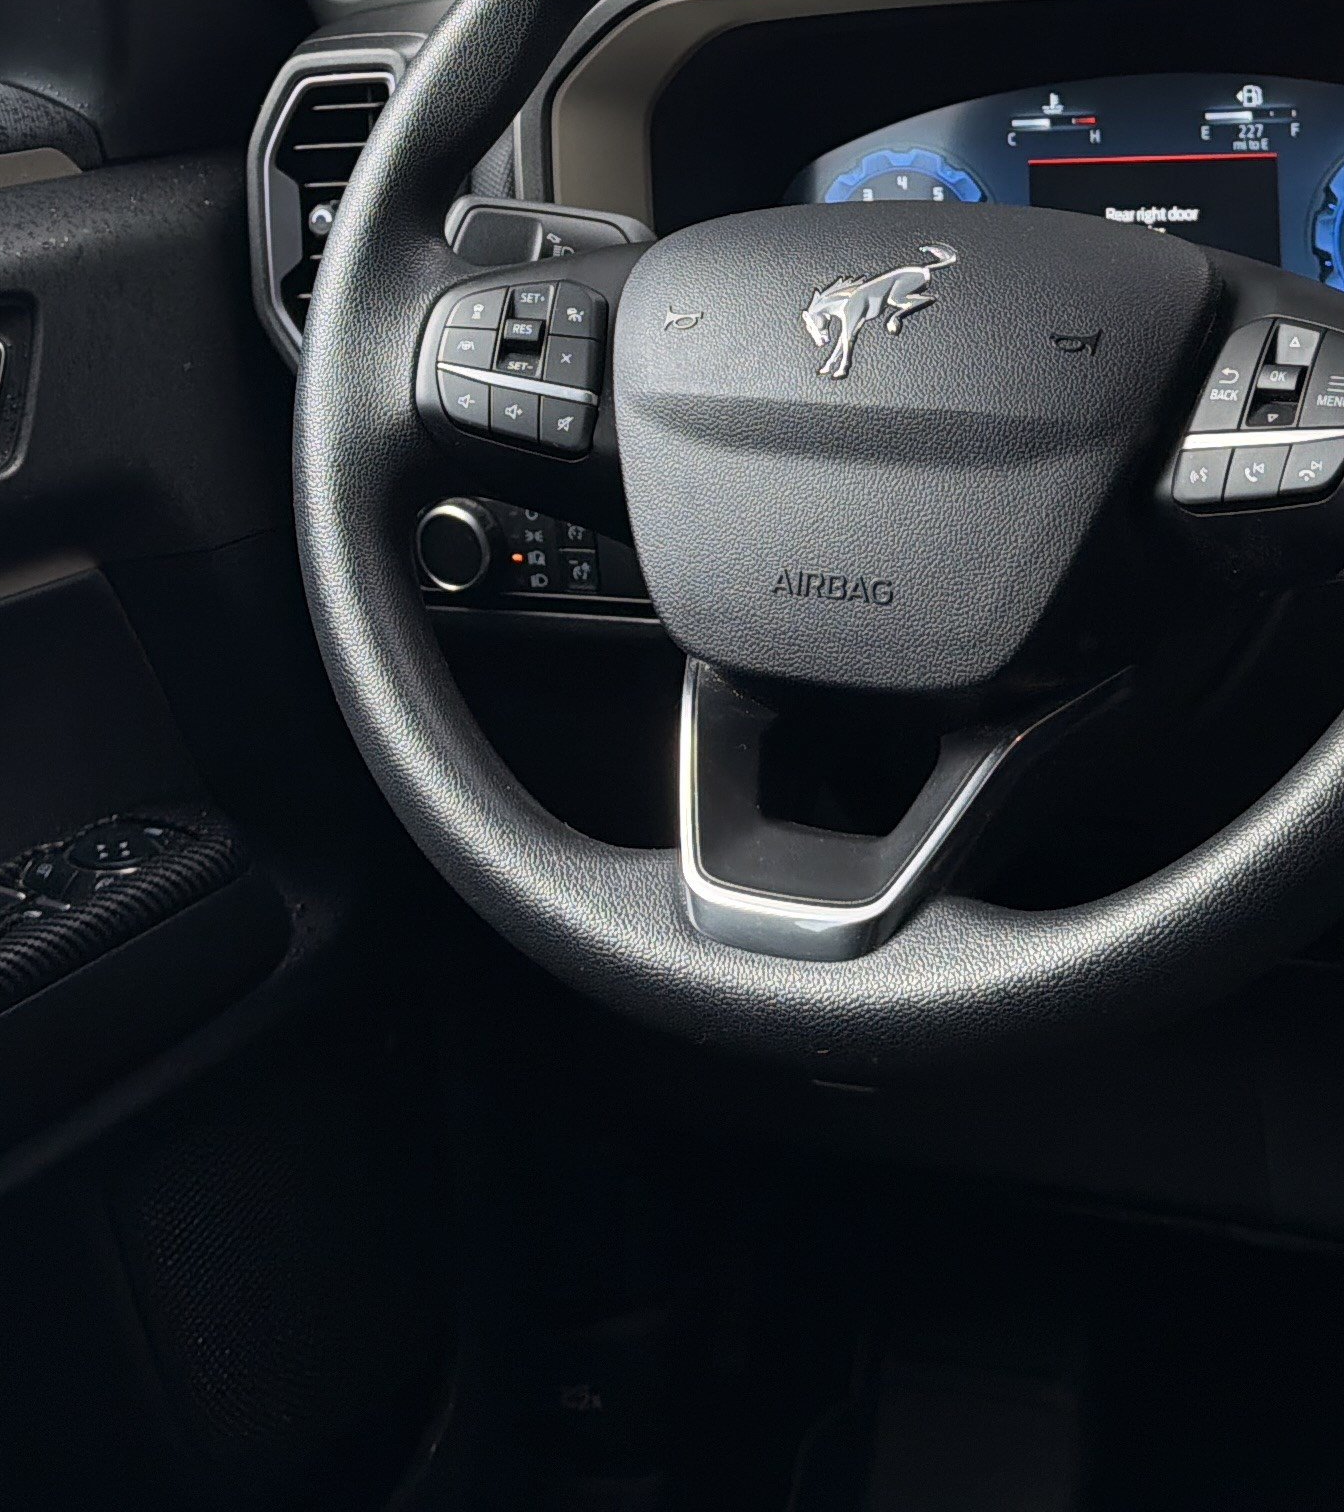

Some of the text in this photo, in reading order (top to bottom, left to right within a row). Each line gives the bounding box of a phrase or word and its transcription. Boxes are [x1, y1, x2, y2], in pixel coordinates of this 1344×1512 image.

[1089, 128, 1100, 143] H
[1201, 125, 1210, 140] E
[1239, 124, 1264, 139] 227
[1291, 122, 1299, 137] F
[1007, 131, 1016, 148] C
[1233, 139, 1272, 152] mi to E
[897, 176, 907, 190] 4
[933, 187, 943, 201] 5
[1106, 206, 1199, 224] Rear right door
[512, 324, 532, 334] RES
[1269, 371, 1287, 383] OK
[1209, 389, 1238, 401] BACK
[772, 569, 894, 605] AIRBAG
